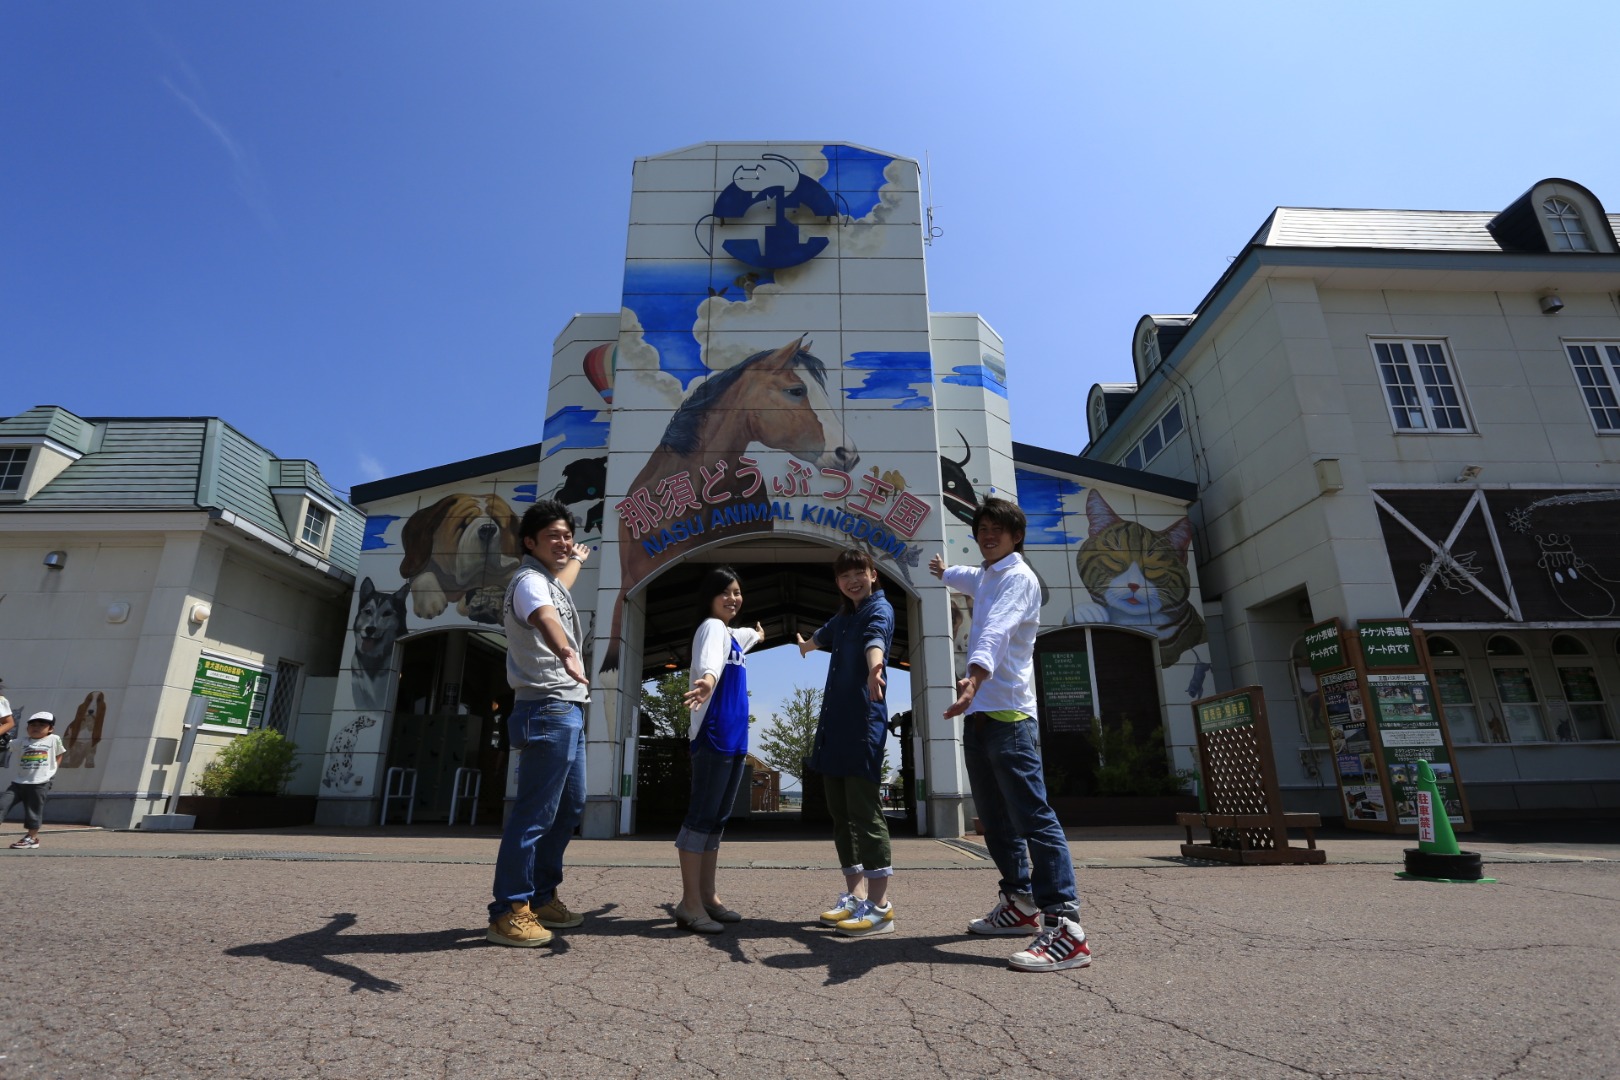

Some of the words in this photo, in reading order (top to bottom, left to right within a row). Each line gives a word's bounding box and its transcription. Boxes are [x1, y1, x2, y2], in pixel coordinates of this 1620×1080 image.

[614, 456, 931, 539] 那須どうぶつ王国
[641, 515, 705, 558] NASU
[711, 501, 795, 530] ANIMAL
[800, 503, 907, 559] KINGDOM
[1305, 626, 1338, 645] チケット売場は
[1360, 626, 1411, 637] チケット売場は
[1310, 644, 1338, 661] ゲート内です
[1367, 644, 1410, 655] ゲート内です
[1418, 793, 1431, 840] 駐車禁止
